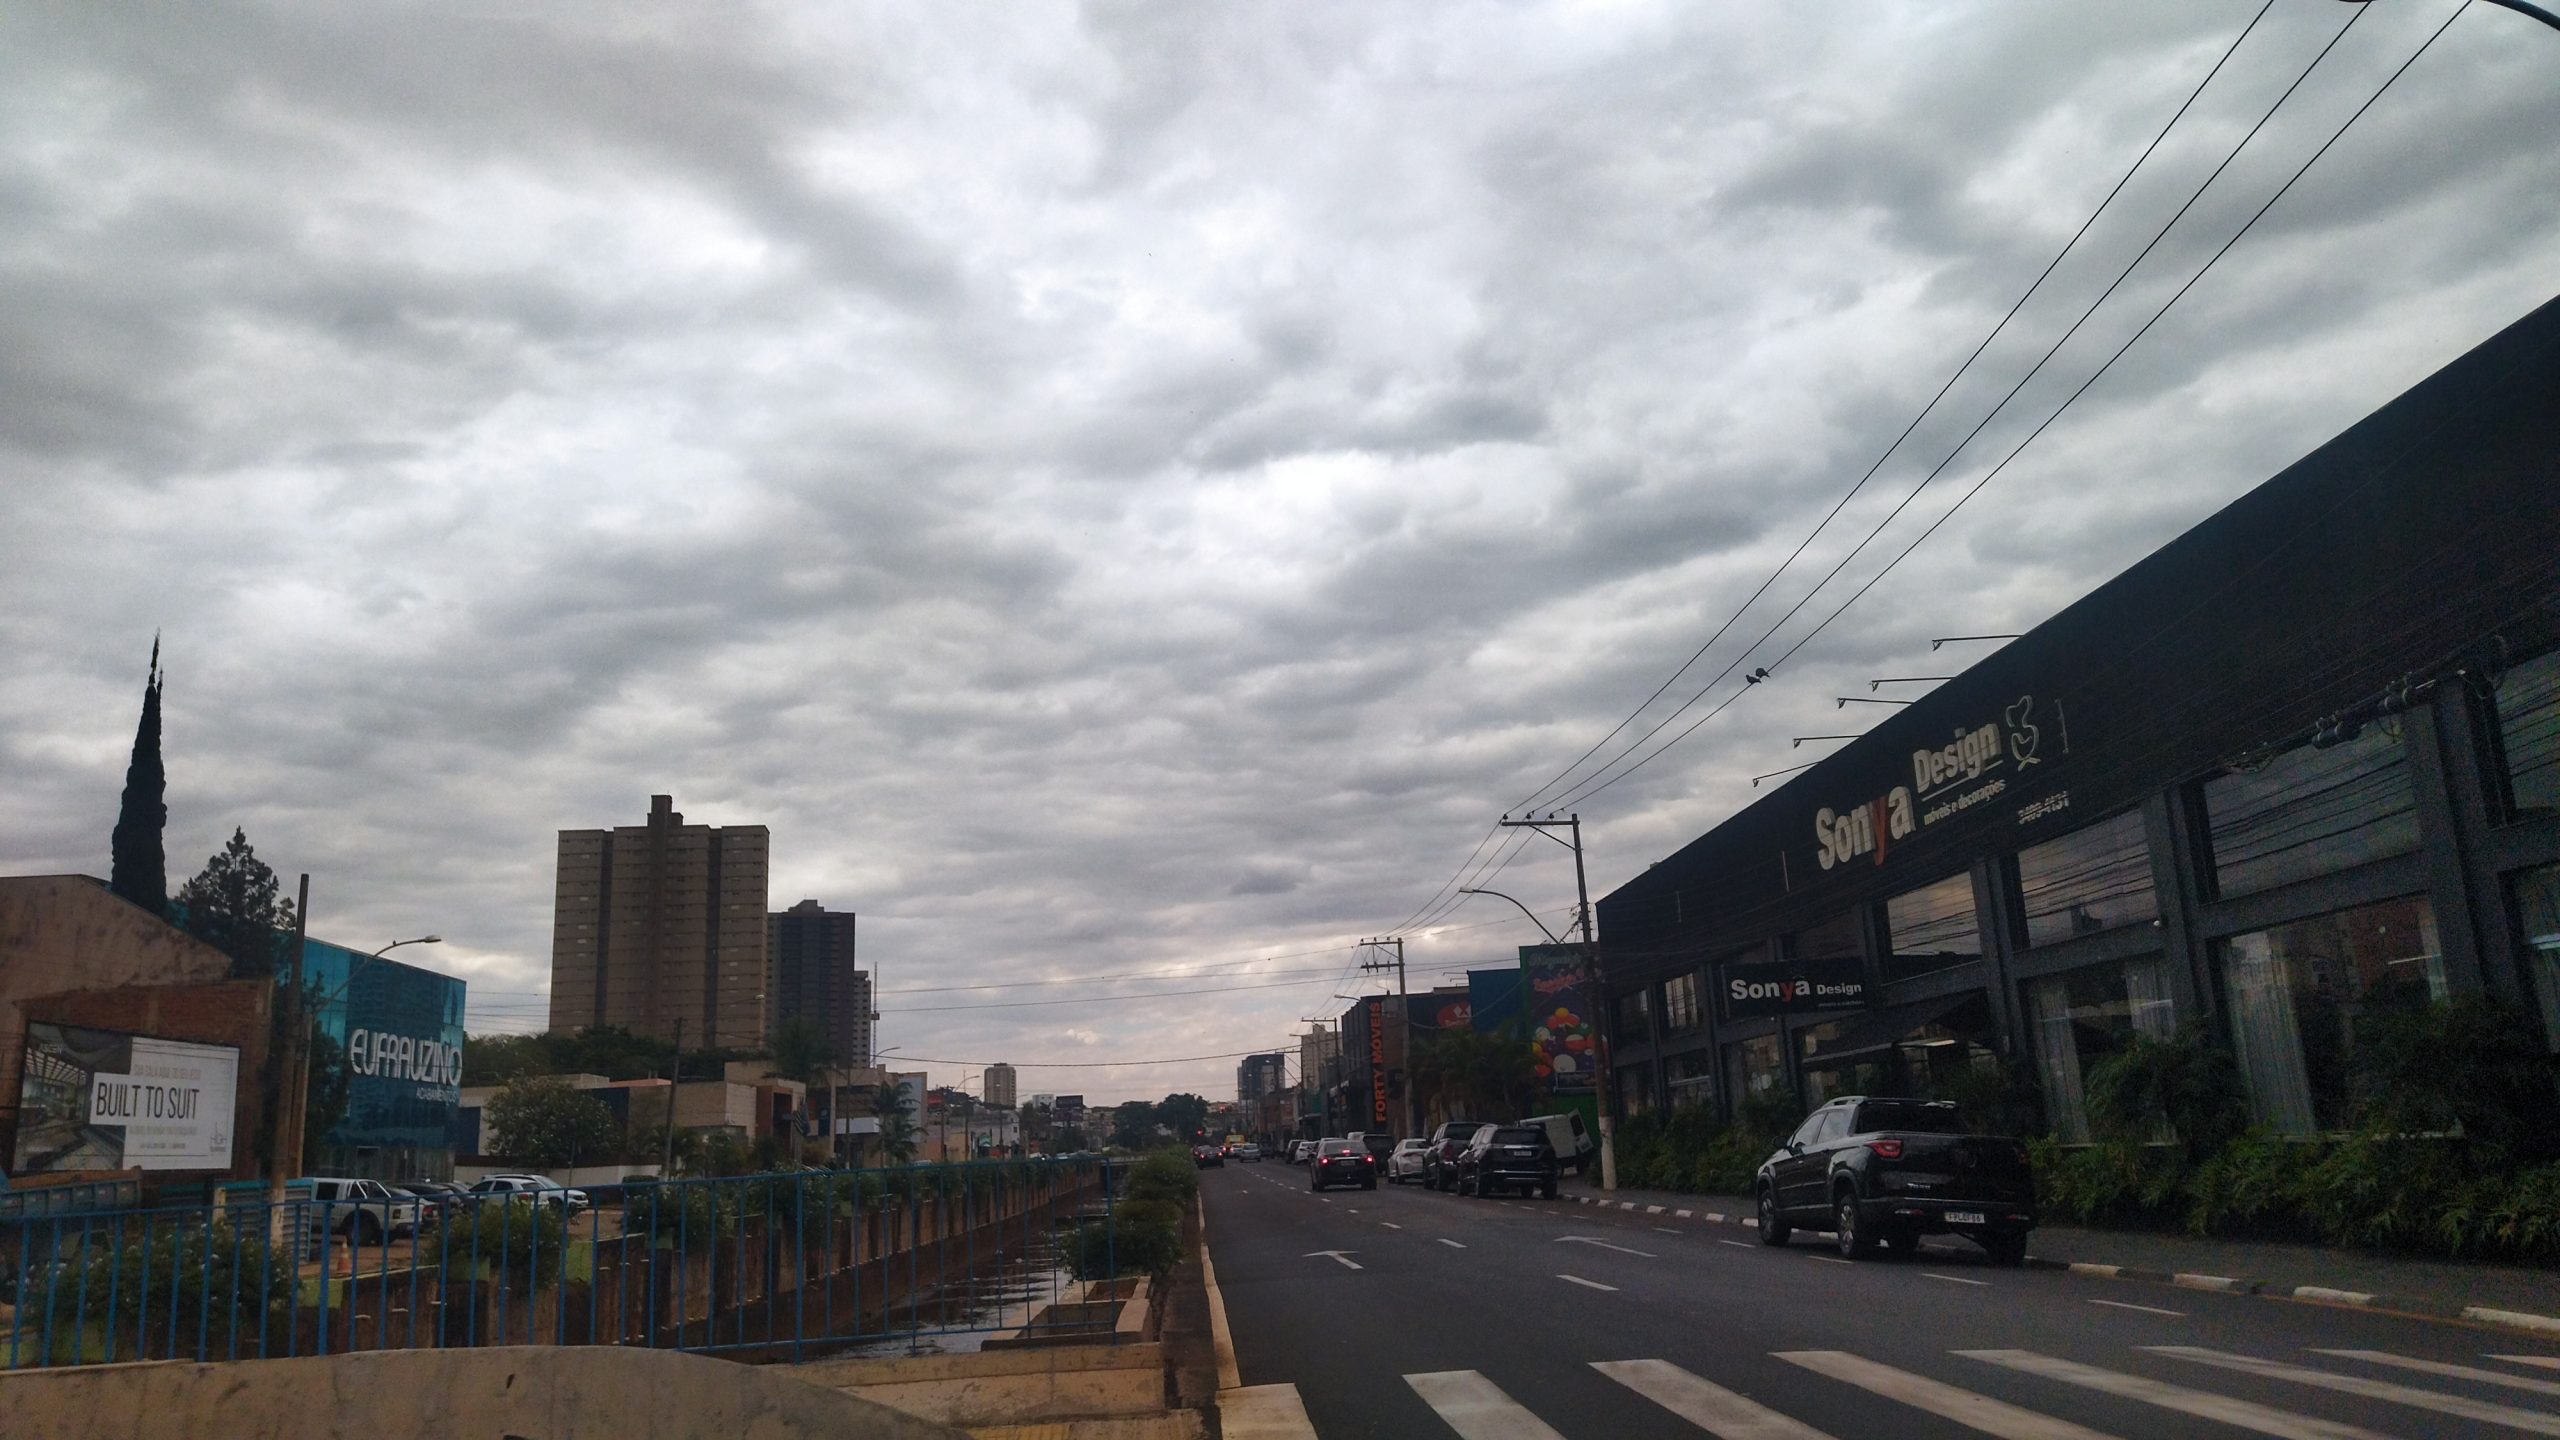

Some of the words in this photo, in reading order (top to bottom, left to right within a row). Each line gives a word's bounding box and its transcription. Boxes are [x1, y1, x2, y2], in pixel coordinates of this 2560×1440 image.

[1816, 785, 1916, 871] Sonya
[1912, 723, 2002, 793] Design
[1731, 979, 1811, 1004] Sonya
[1816, 982, 1862, 996] Design
[350, 1028, 462, 1086] EUFRAUZINO
[96, 1082, 141, 1117] BUILT
[146, 1086, 164, 1118] TO
[168, 1087, 200, 1120] SUIT
[1374, 1068, 1387, 1121] FORTY
